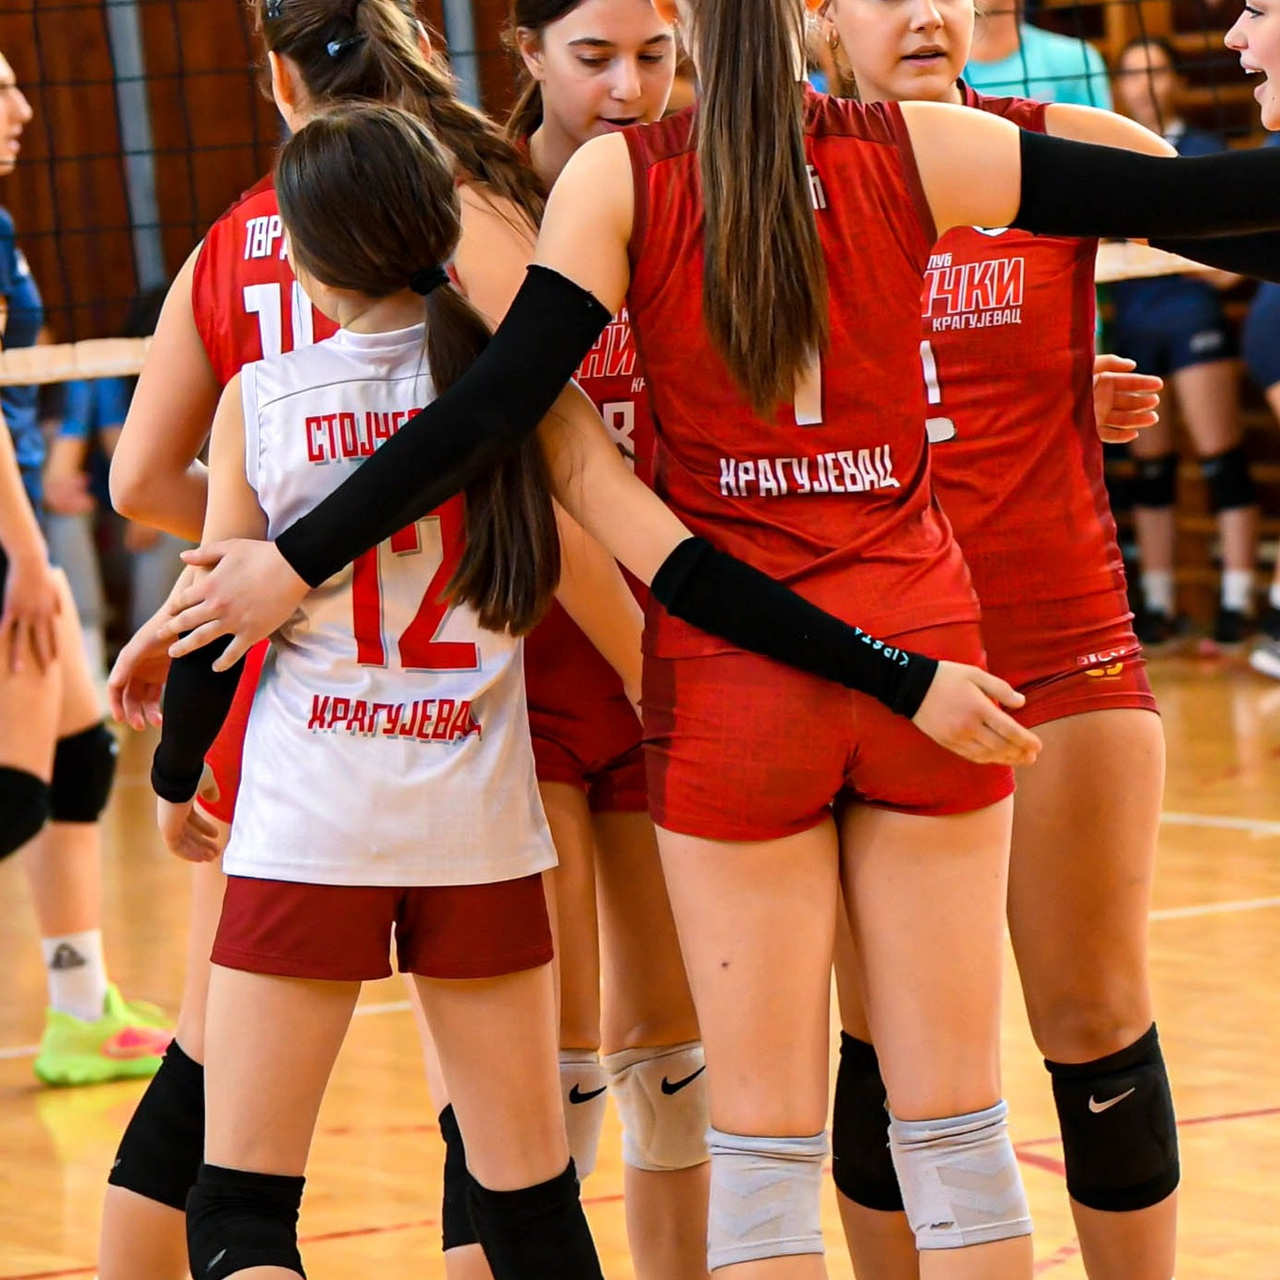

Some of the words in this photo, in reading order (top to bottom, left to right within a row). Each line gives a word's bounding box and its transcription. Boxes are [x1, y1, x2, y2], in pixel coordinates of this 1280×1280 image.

[932, 307, 1022, 332] КРАГУЈЕВАЦ
[719, 443, 901, 497] КРАГУЈЕВАЦ
[352, 490, 479, 671] 12
